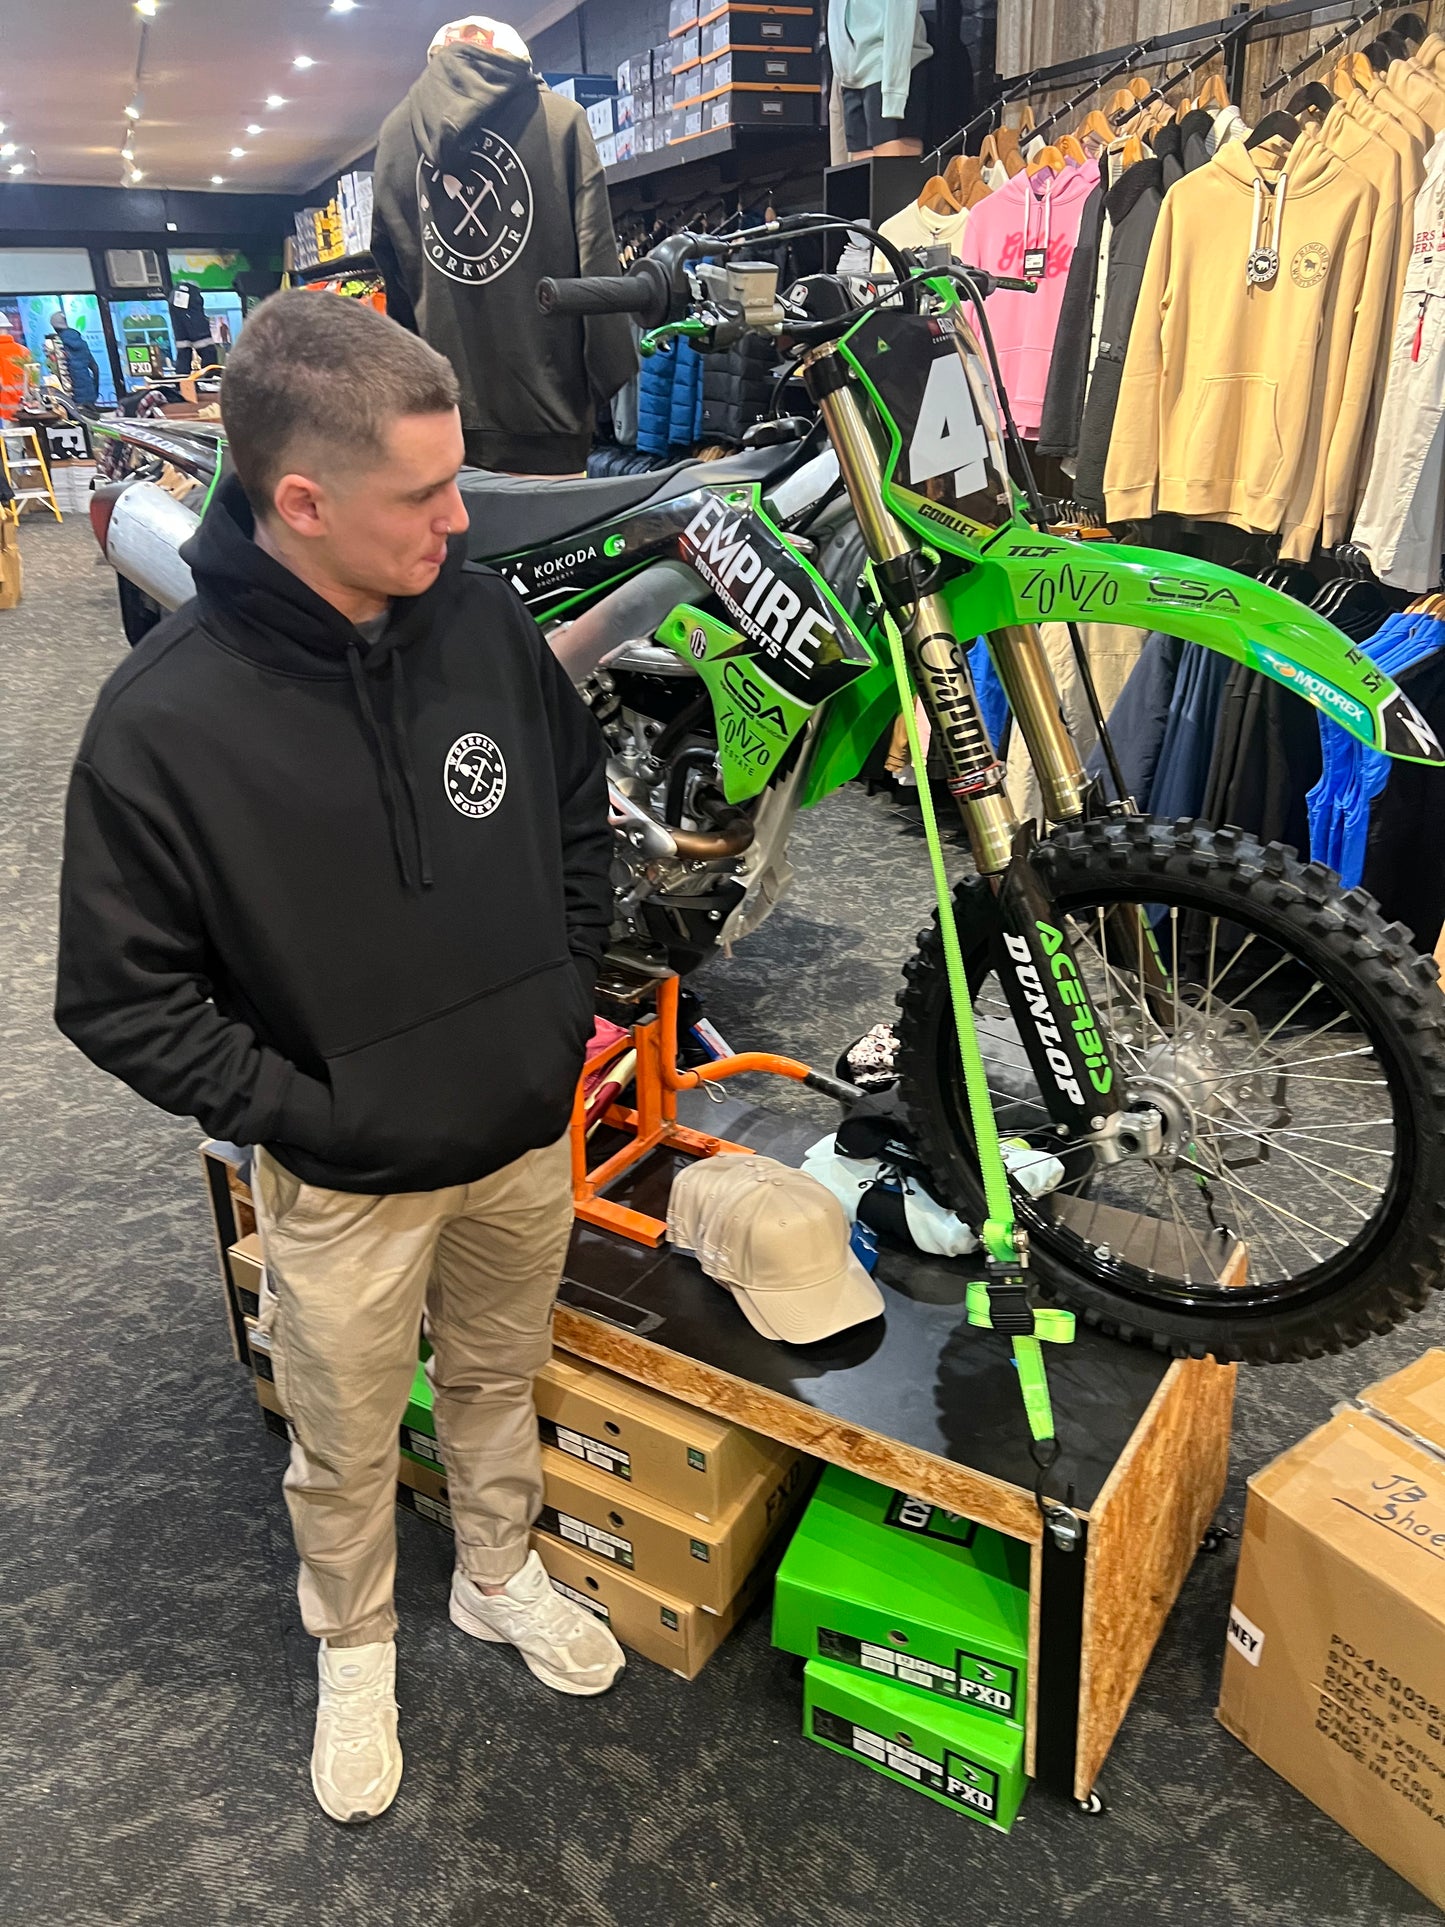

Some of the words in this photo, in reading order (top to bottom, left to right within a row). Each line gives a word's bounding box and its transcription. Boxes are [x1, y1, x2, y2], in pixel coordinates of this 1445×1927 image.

[422, 224, 522, 277] WORKWEAR
[130, 361, 152, 374] FXD
[908, 352, 989, 499] 4
[534, 546, 598, 579] KOKODA
[1007, 545, 1067, 558] TCF
[684, 497, 837, 669] EMPIRE
[694, 555, 782, 660] MOTORSPORTS
[1021, 563, 1118, 614] ZONZO
[1150, 576, 1241, 608] CSA
[723, 661, 789, 736] CSA
[1294, 670, 1365, 722] MOTOREX
[448, 736, 495, 766] WORKPIT
[720, 705, 770, 767] ZONZO
[724, 744, 755, 777] ESTATE
[1002, 932, 1085, 1105] DUNLOP
[1371, 1474, 1428, 1503] JB
[959, 1678, 1012, 1711] FXD
[1325, 1665, 1373, 1705] SIZE:
[1328, 1650, 1386, 1699] STYLE
[946, 1775, 994, 1812] FXD
[1315, 1719, 1367, 1764] MADE
[1368, 1760, 1388, 1781] IN
[1390, 1778, 1445, 1828] CHINA
